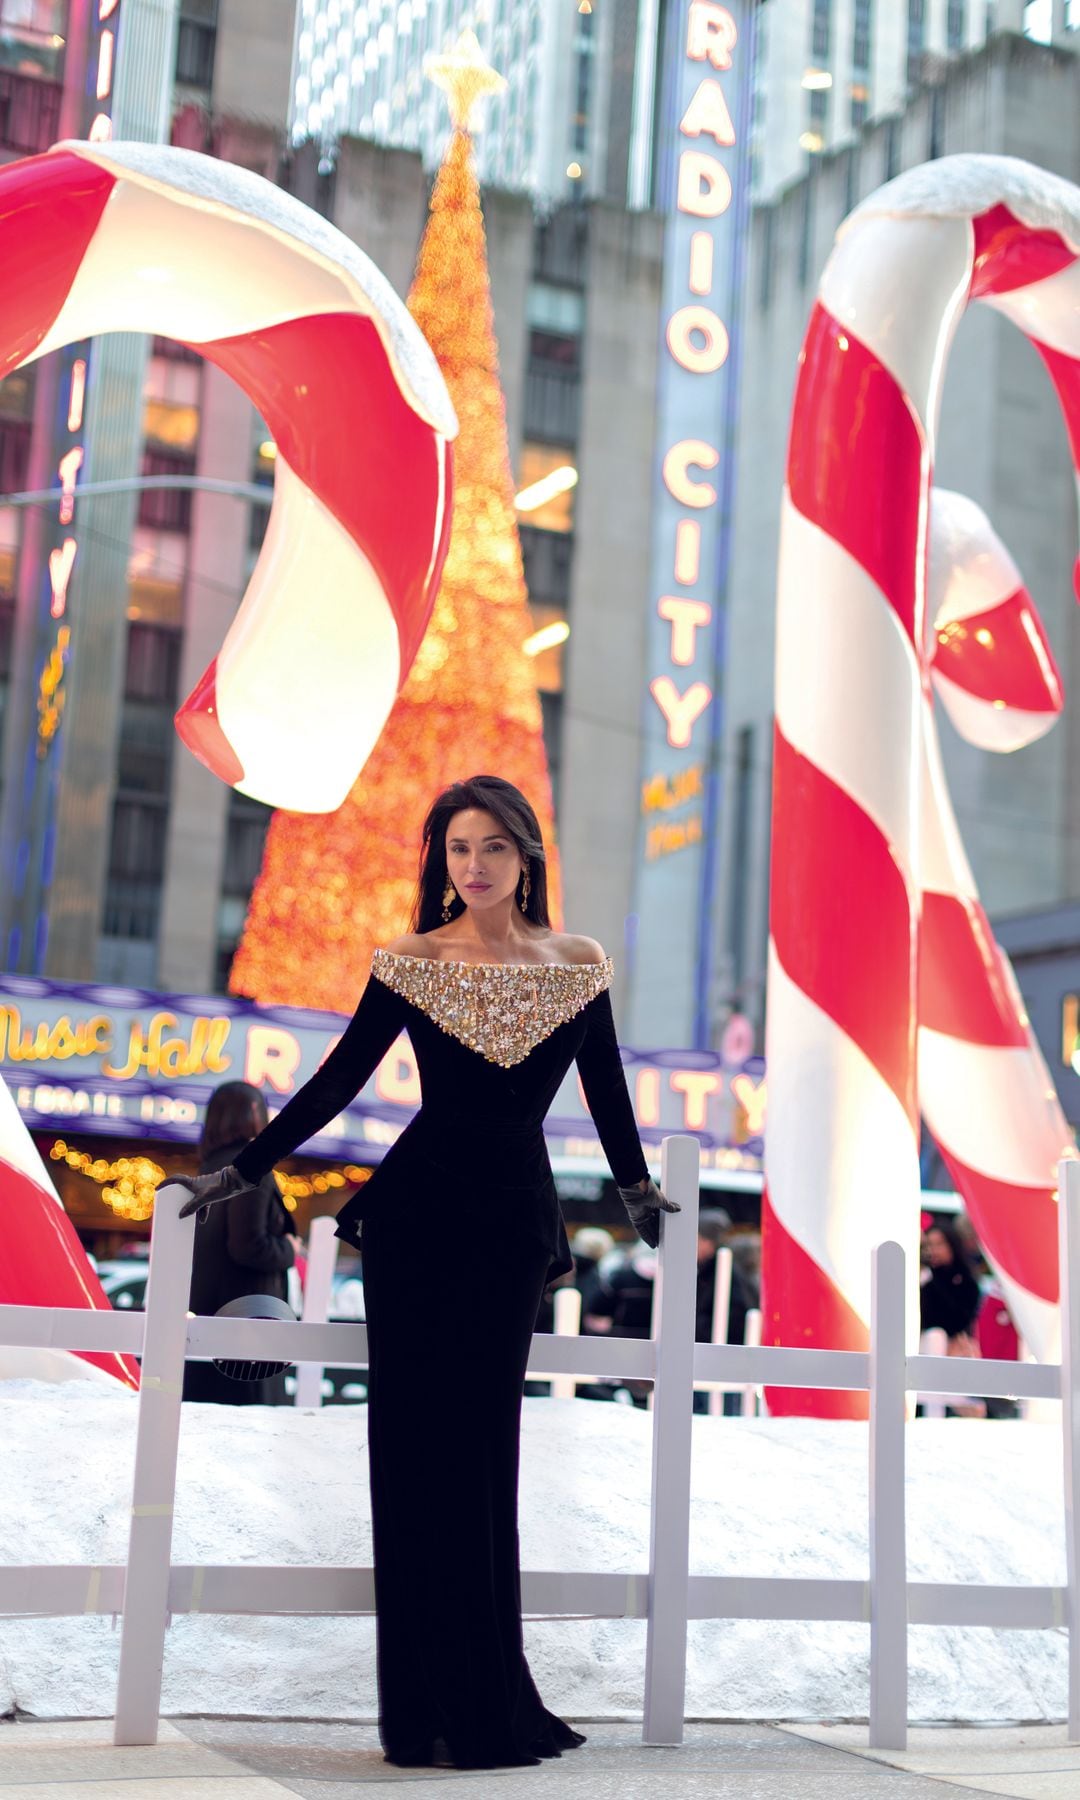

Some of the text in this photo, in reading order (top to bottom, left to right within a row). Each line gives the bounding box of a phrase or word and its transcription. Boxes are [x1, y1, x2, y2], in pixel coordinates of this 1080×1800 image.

[650, 0, 738, 749] RADIO CITY
[102, 1011, 232, 1080] Hall
